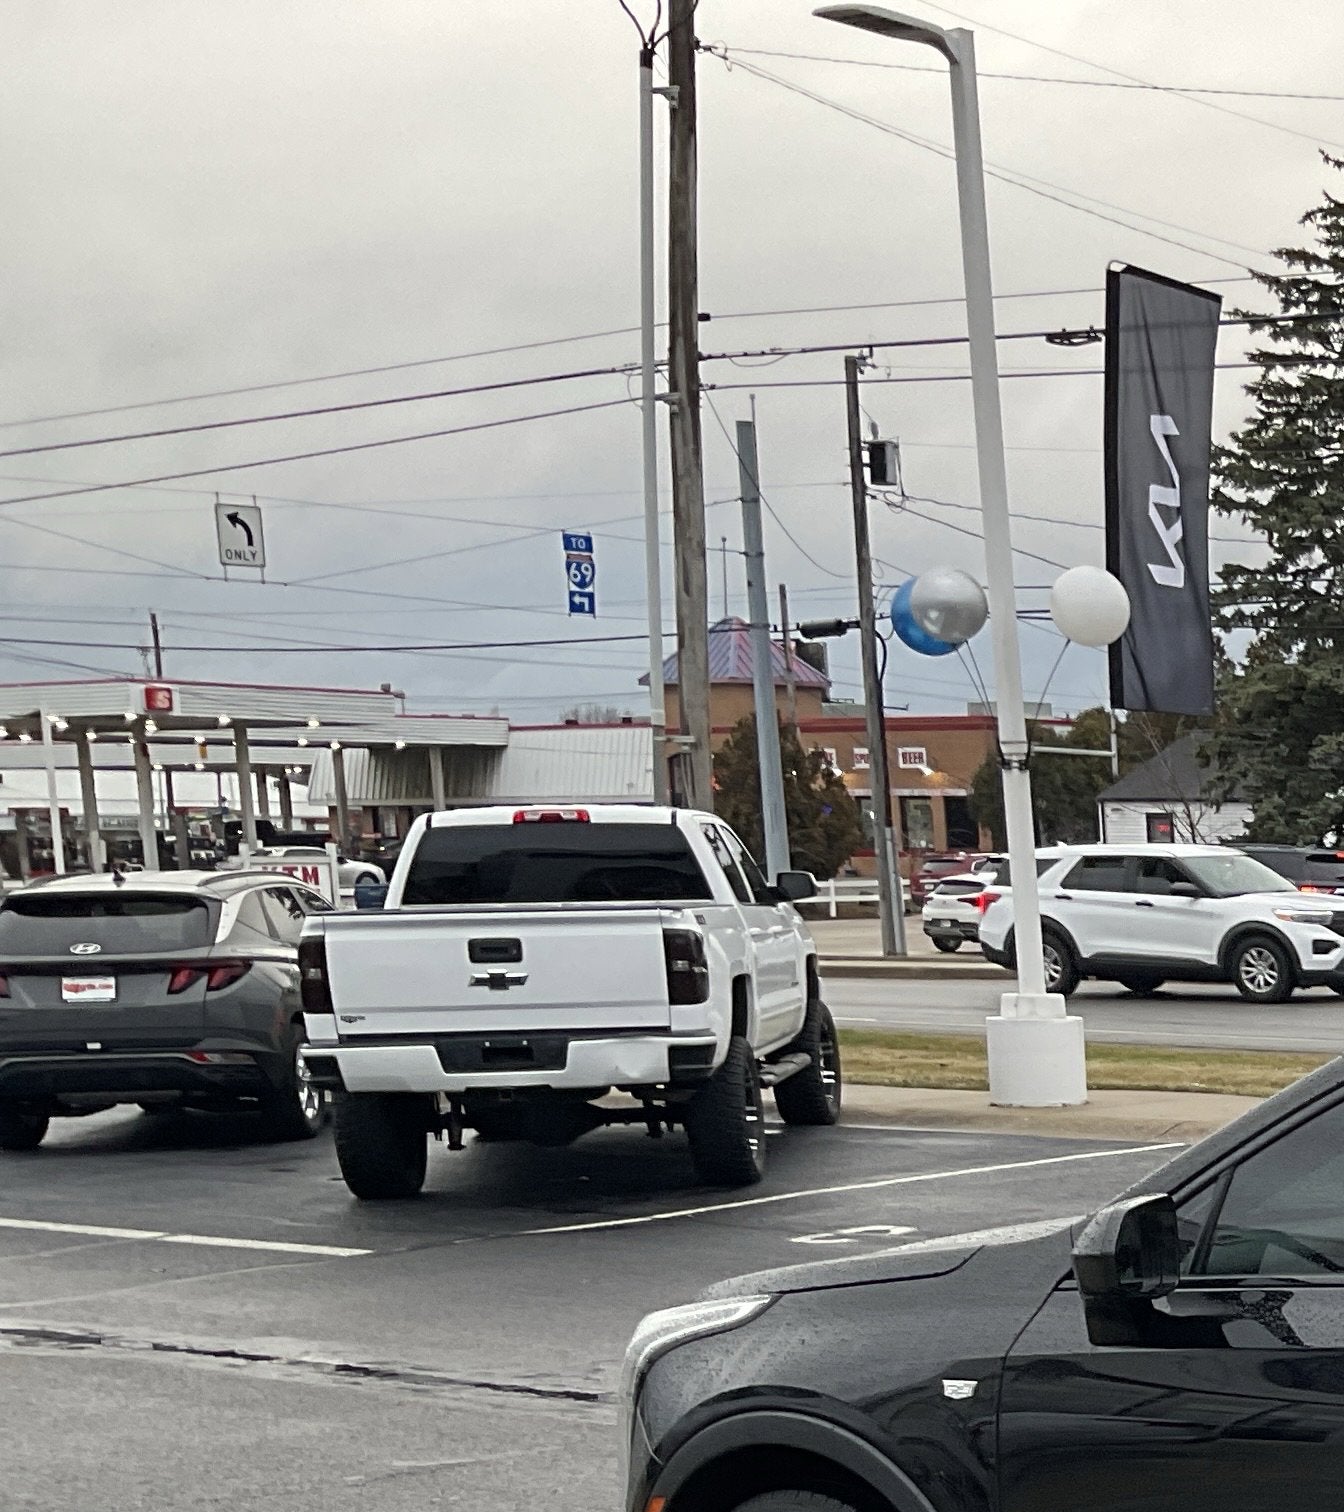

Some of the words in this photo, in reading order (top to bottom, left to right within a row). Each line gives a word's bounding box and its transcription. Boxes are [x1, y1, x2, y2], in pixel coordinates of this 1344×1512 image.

[570, 537, 586, 549] TO
[225, 549, 257, 561] ONLY
[569, 562, 592, 583] 69
[902, 752, 924, 764] BEER
